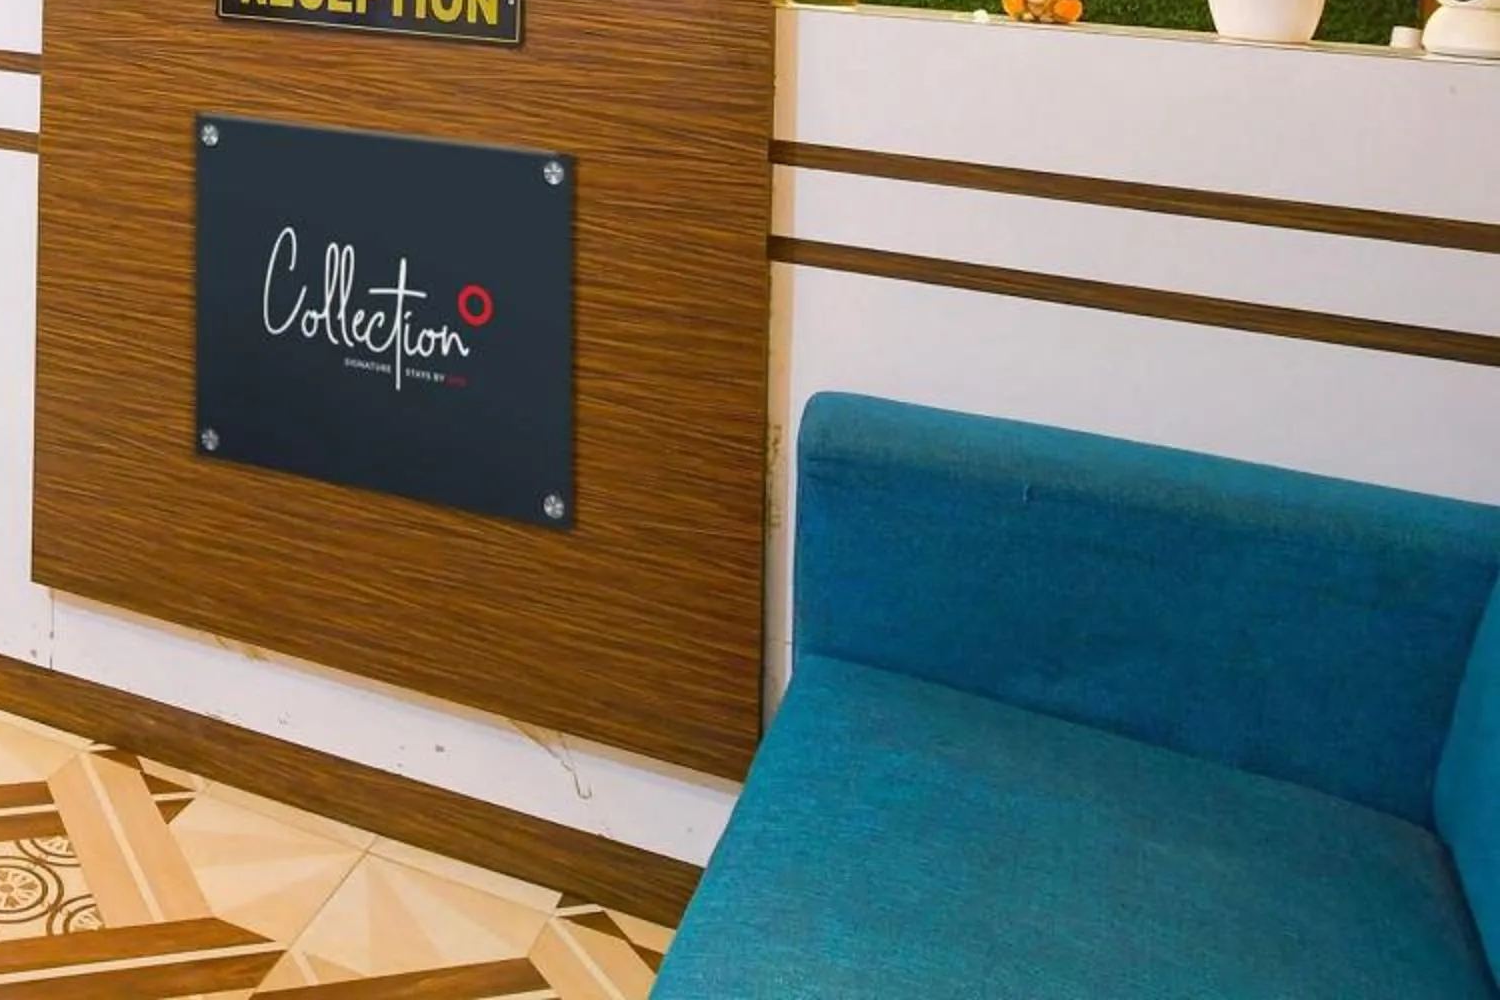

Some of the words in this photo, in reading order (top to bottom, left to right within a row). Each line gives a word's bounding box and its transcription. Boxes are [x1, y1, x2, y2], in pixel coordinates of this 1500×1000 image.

[262, 226, 470, 391] Collection
[344, 357, 392, 374] SIGNATURE
[405, 367, 431, 381] STAYS
[433, 372, 446, 383] BY
